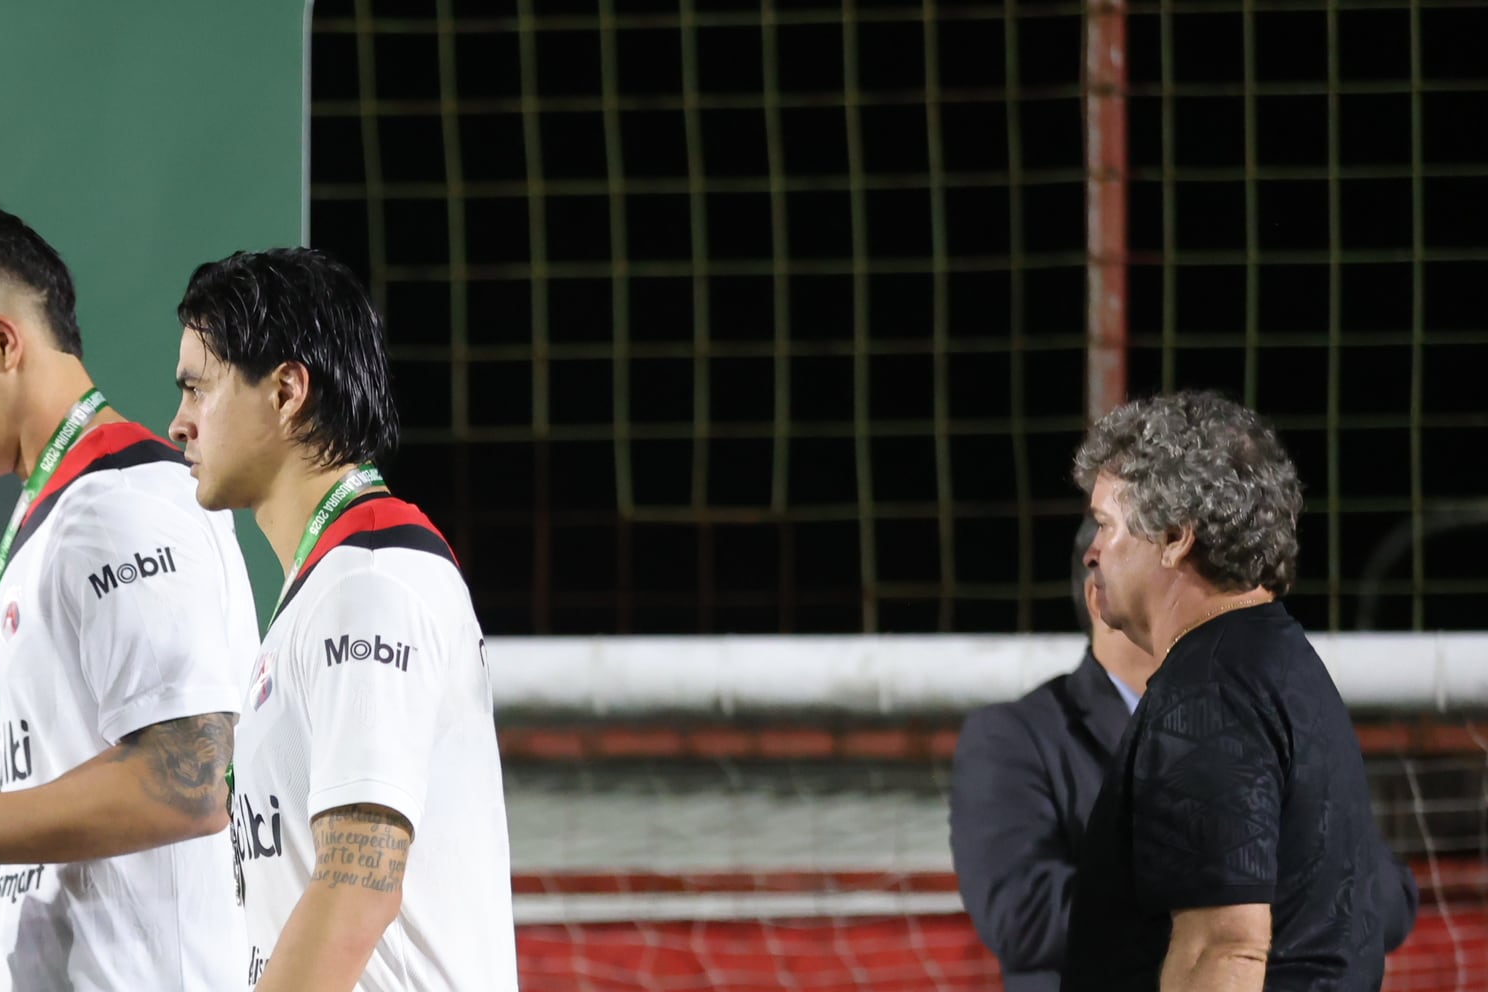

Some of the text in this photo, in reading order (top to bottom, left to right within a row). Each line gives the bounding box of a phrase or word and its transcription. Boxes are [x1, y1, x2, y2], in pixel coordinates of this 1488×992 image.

[323, 475, 362, 512] CLAUSURA
[309, 509, 329, 536] 2025
[88, 546, 176, 600] Mobil
[324, 634, 410, 672] Mobil
